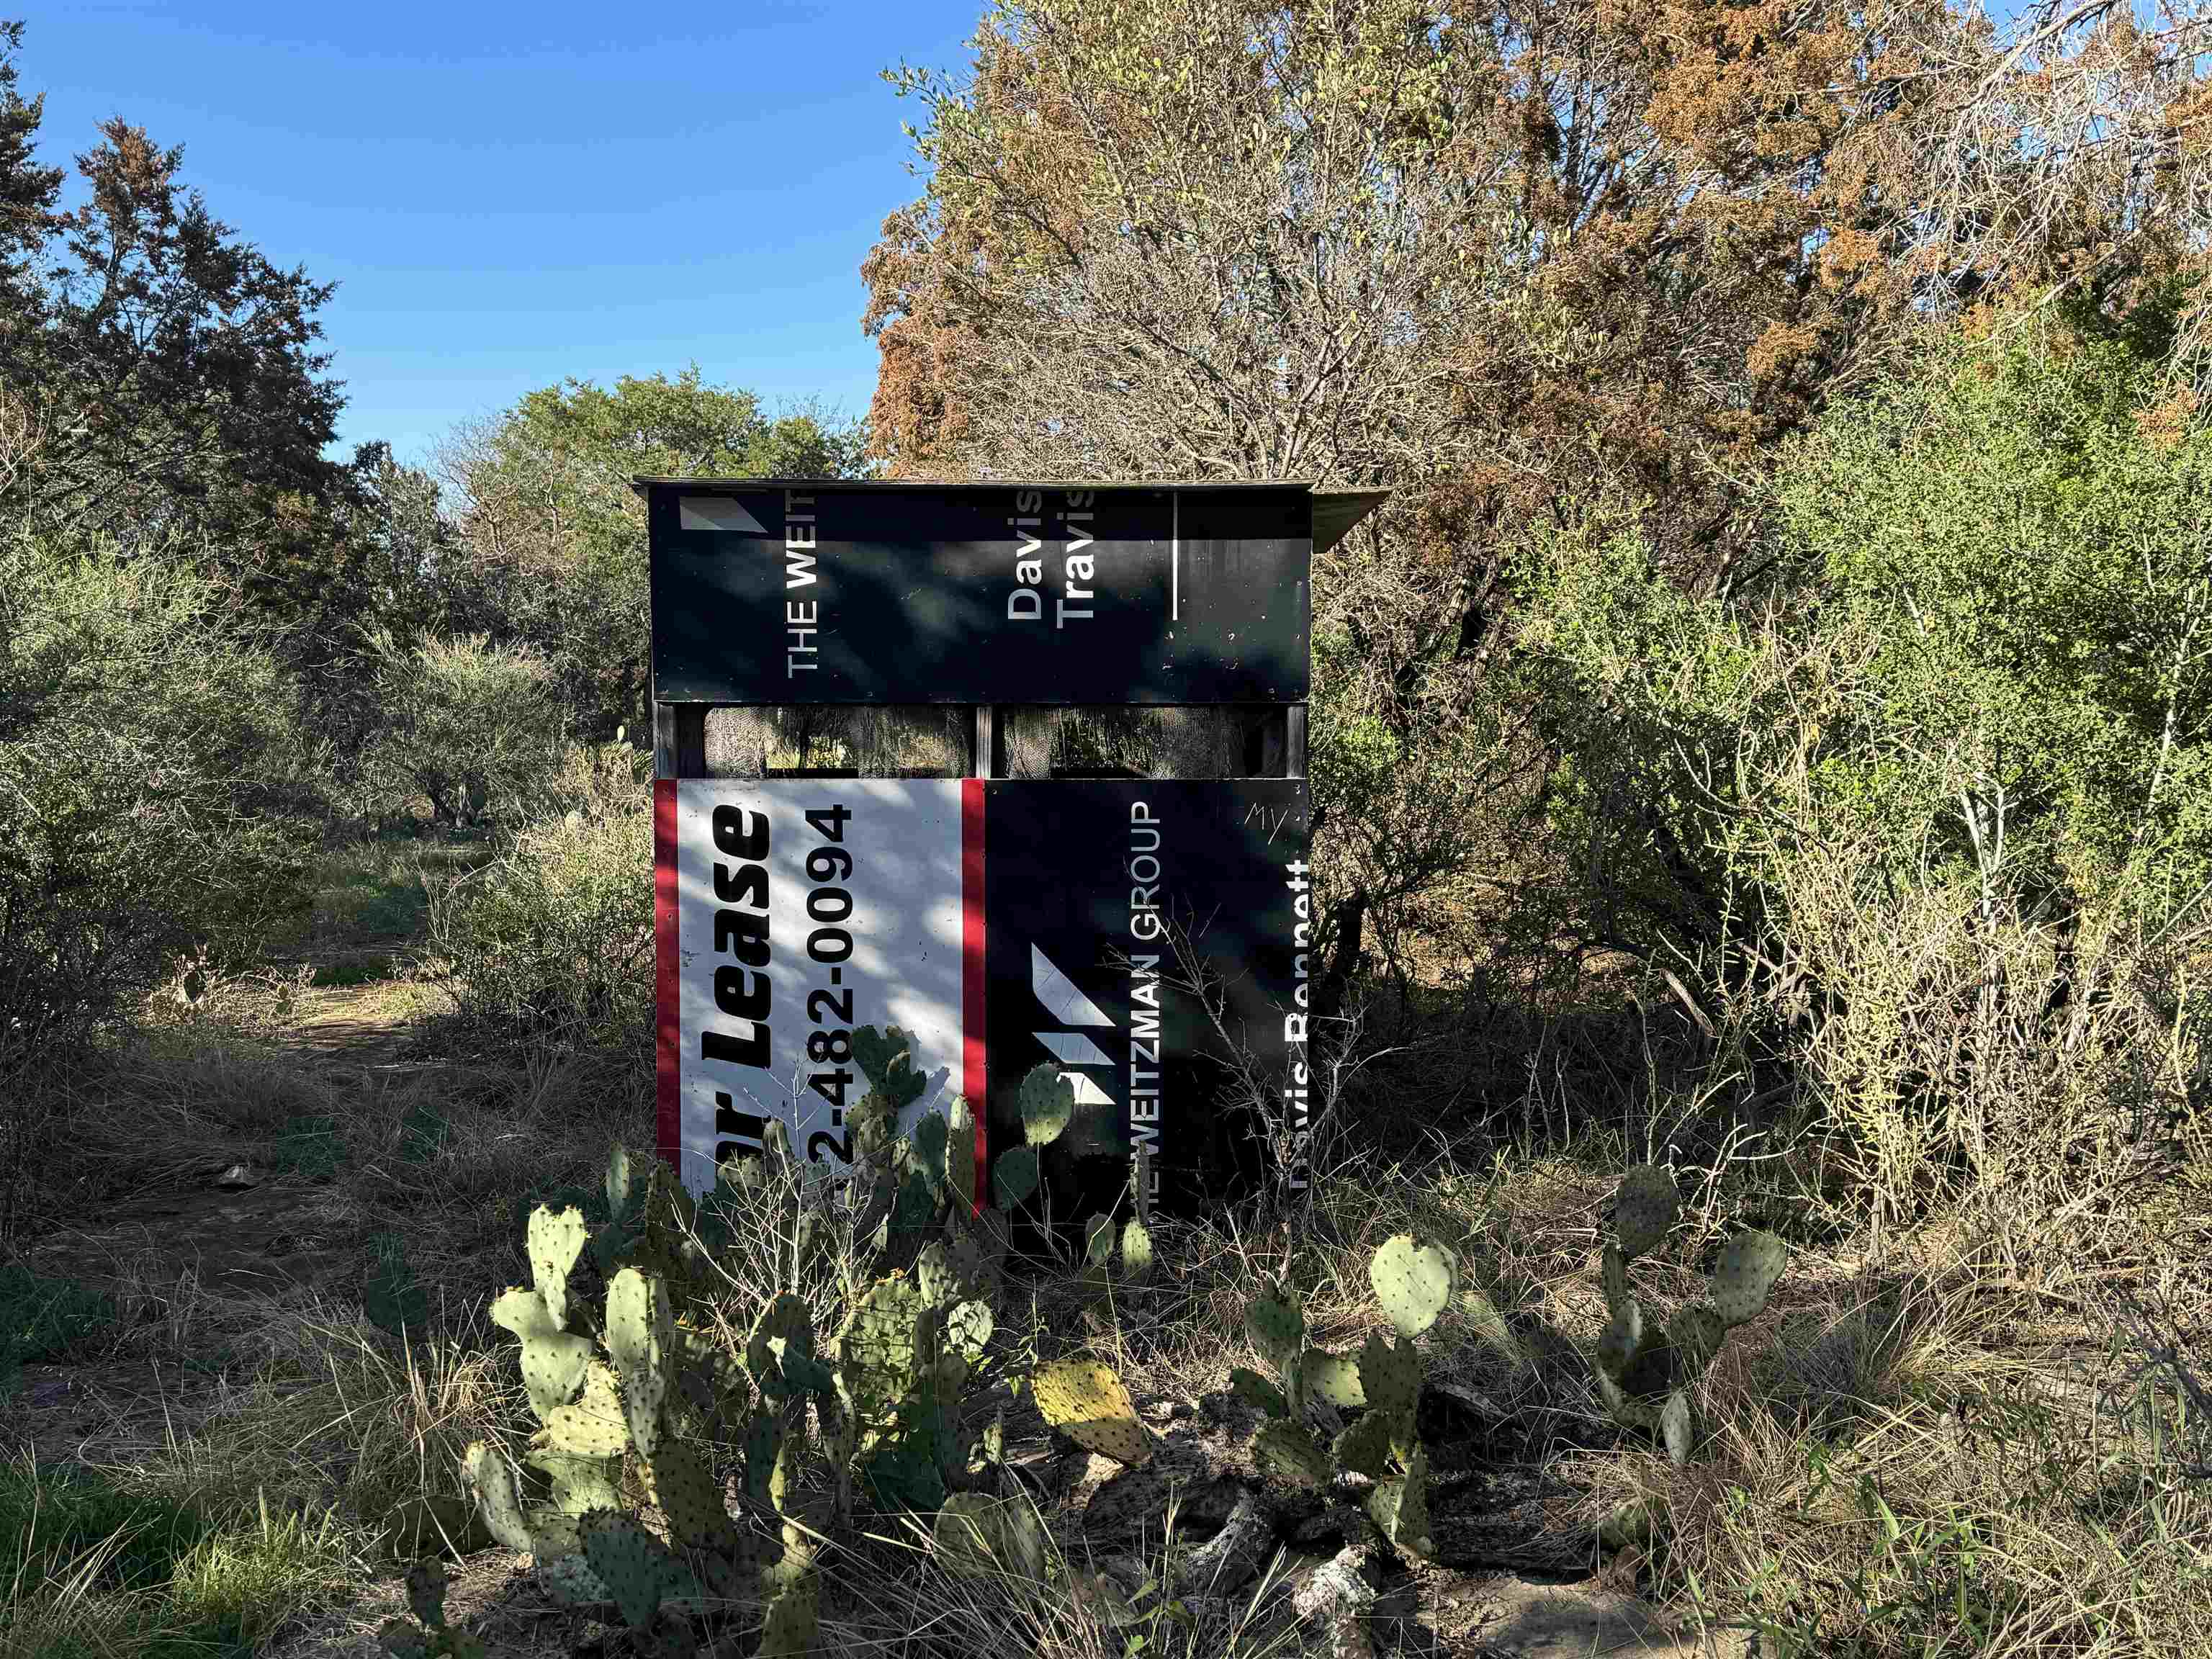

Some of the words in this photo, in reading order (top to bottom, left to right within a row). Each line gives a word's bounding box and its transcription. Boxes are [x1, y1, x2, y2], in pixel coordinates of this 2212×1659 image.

[784, 490, 817, 589] WEIT
[1007, 490, 1042, 620] Davis
[1056, 491, 1094, 629] Travis
[787, 601, 818, 678] THE
[702, 803, 772, 1069] Lease
[1130, 801, 1161, 940] GROUP
[805, 804, 854, 1190] 2-482-0094
[1130, 955, 1160, 1159] WEITZMAN
